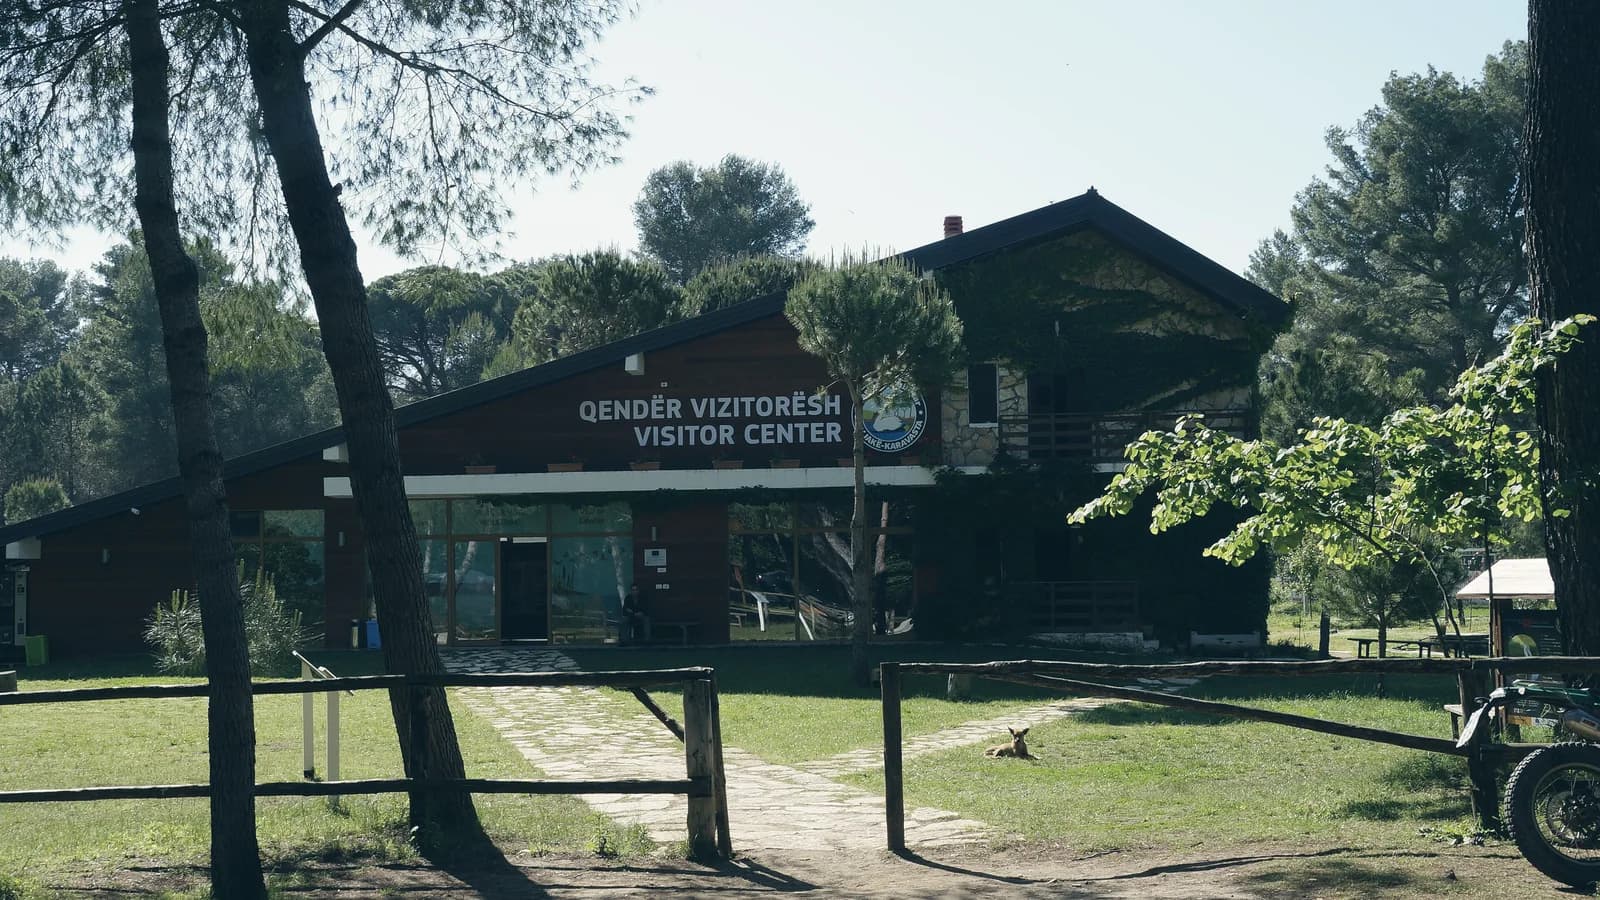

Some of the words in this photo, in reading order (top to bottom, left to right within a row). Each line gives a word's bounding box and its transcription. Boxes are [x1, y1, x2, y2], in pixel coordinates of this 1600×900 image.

[579, 394, 682, 423] QENDËR
[689, 390, 841, 418] VIZITORËSH
[633, 424, 735, 447] VISITOR
[744, 422, 842, 445] CENTER
[863, 420, 924, 450] JAKË-KARAVASTA
